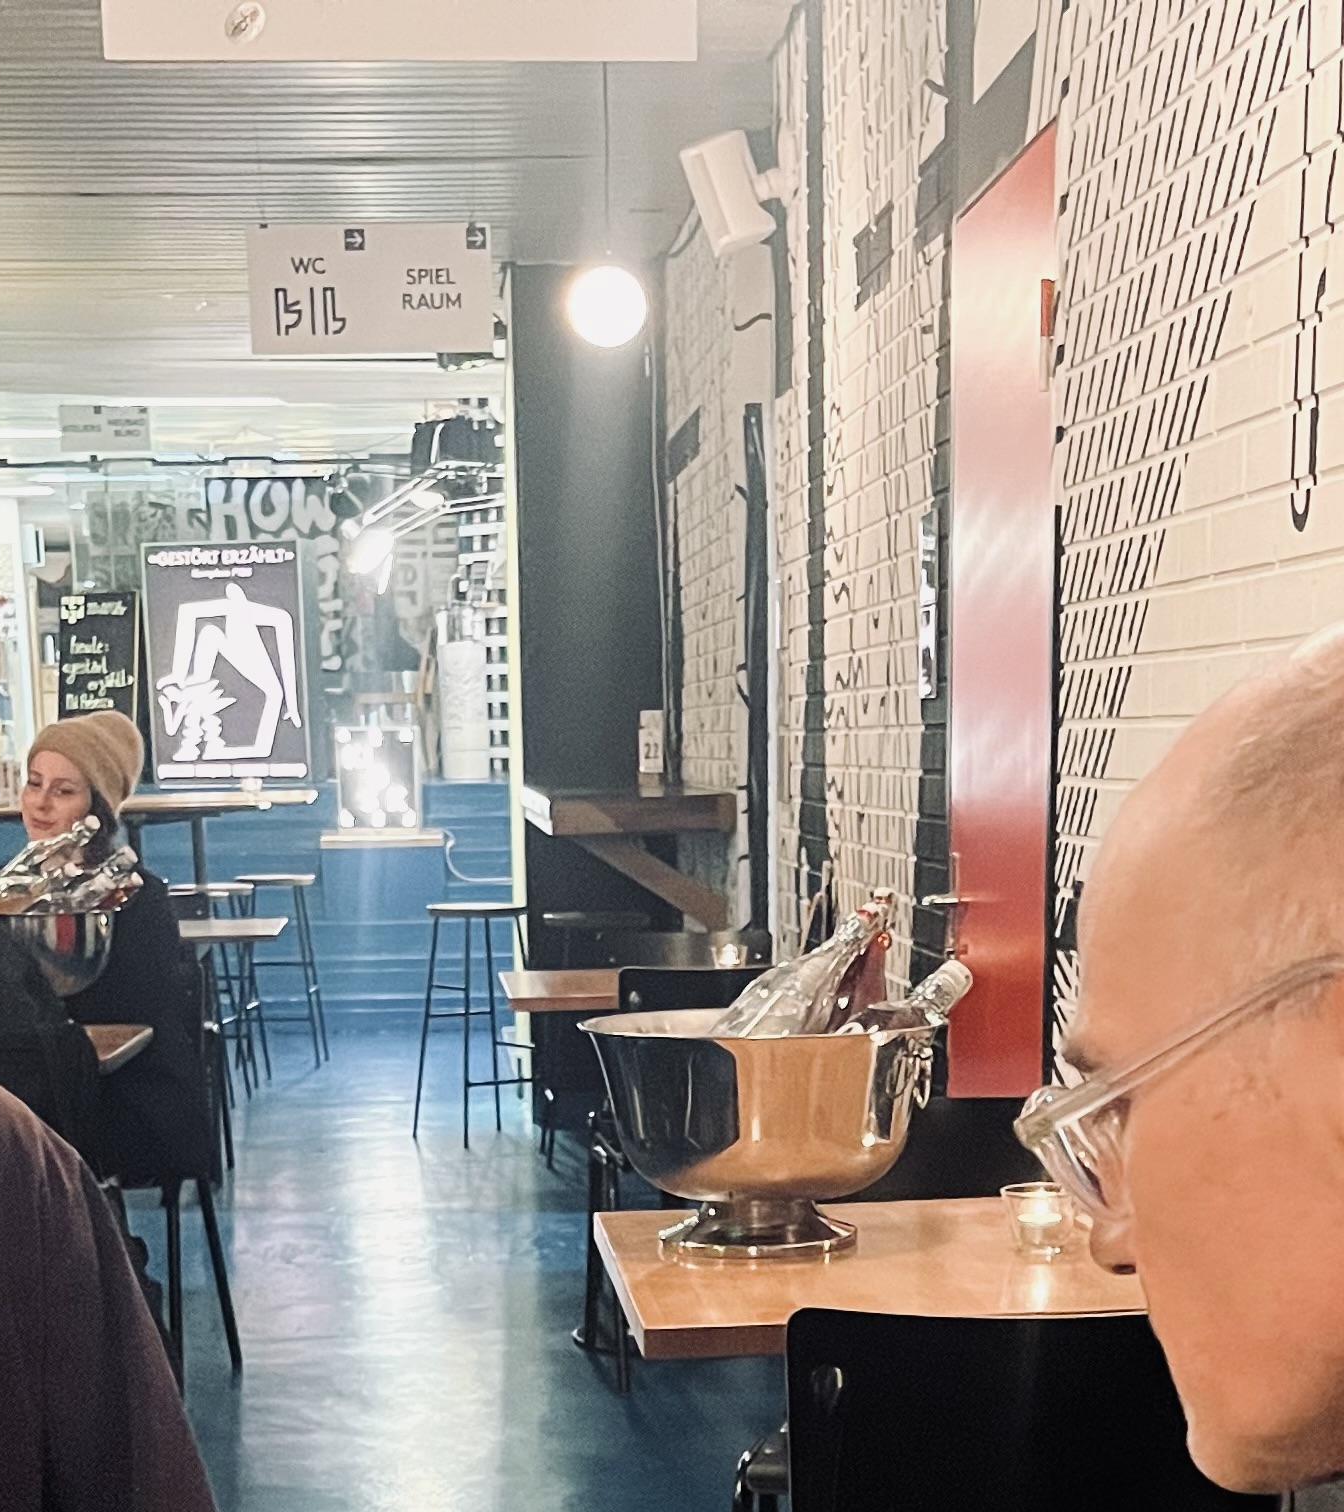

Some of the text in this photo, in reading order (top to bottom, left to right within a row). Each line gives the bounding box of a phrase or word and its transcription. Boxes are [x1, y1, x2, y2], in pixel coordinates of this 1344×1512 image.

[291, 256, 326, 275] WC
[406, 267, 457, 286] SPIEL
[402, 292, 462, 310] RAUM
